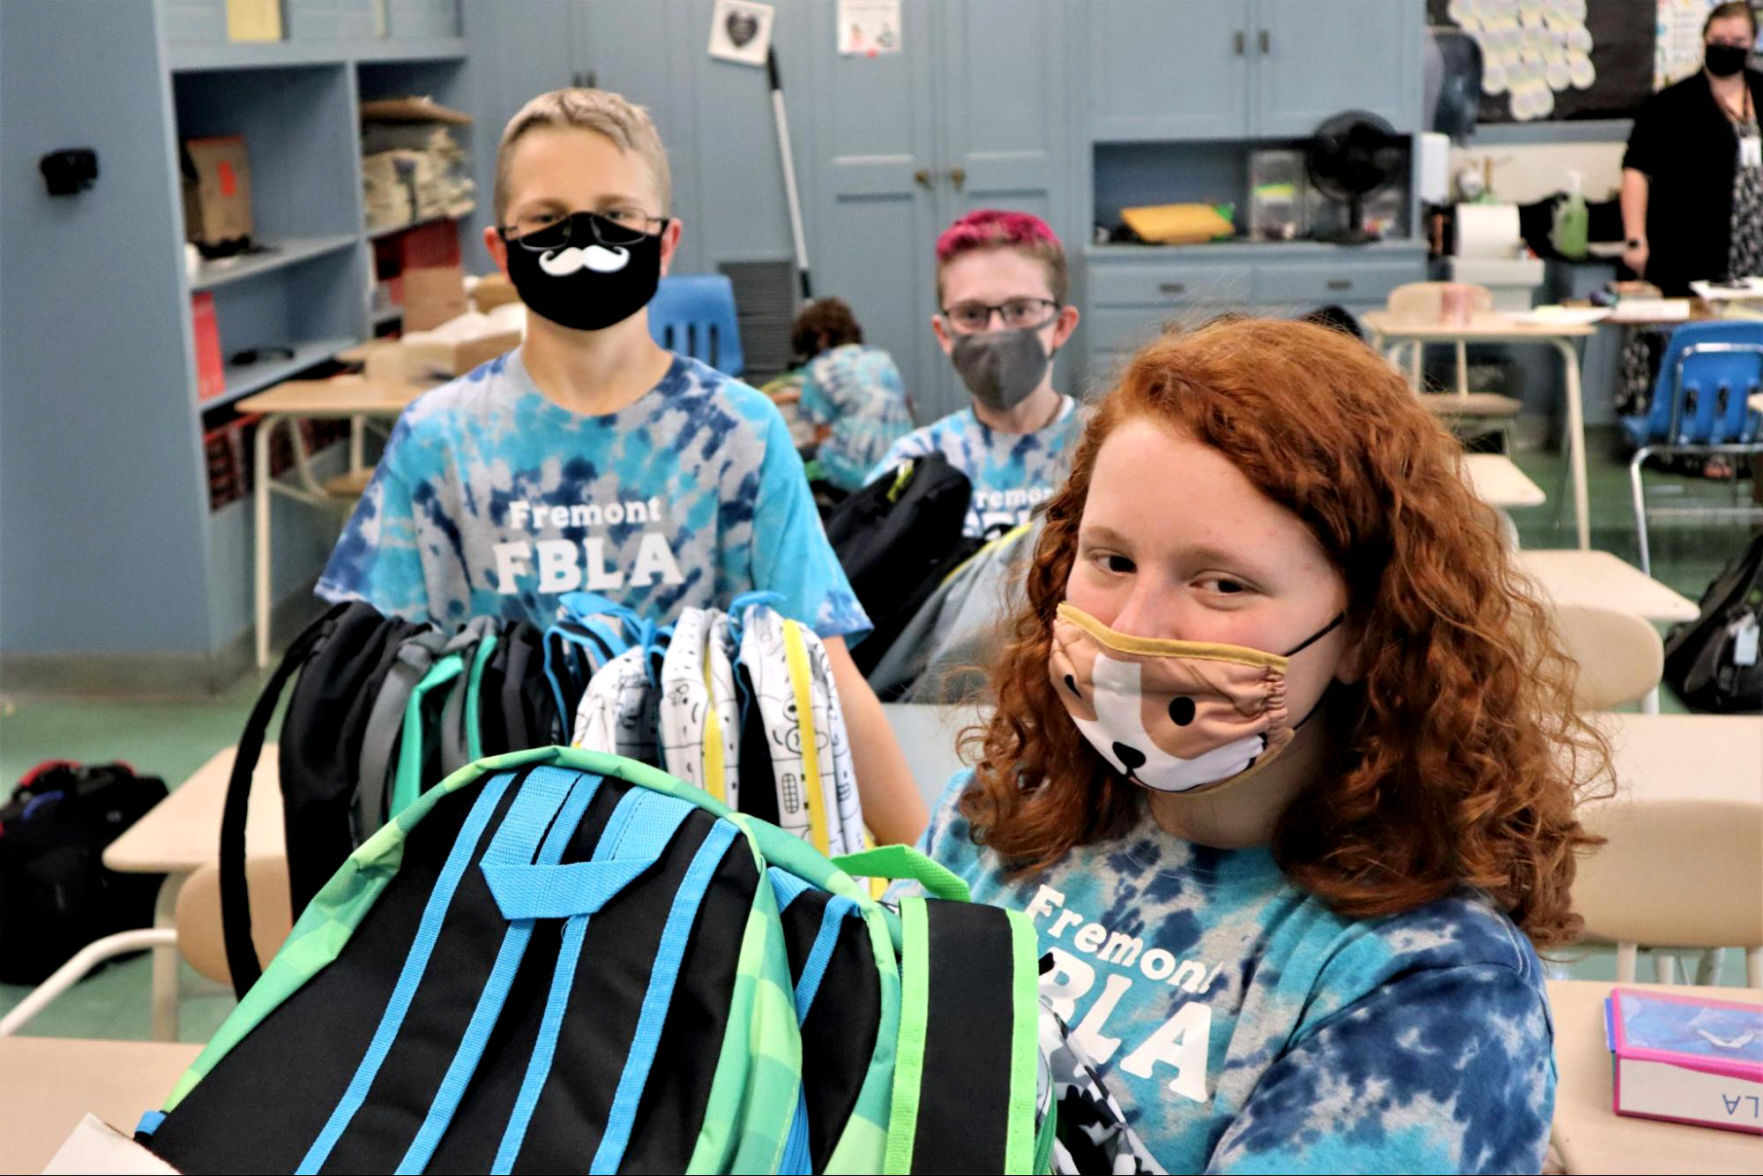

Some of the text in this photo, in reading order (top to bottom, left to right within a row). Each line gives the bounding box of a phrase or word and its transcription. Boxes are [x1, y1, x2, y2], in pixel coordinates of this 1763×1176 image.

[509, 497, 662, 529] Fremont
[493, 532, 685, 595] FBLA
[1038, 946, 1212, 1103] BLA
